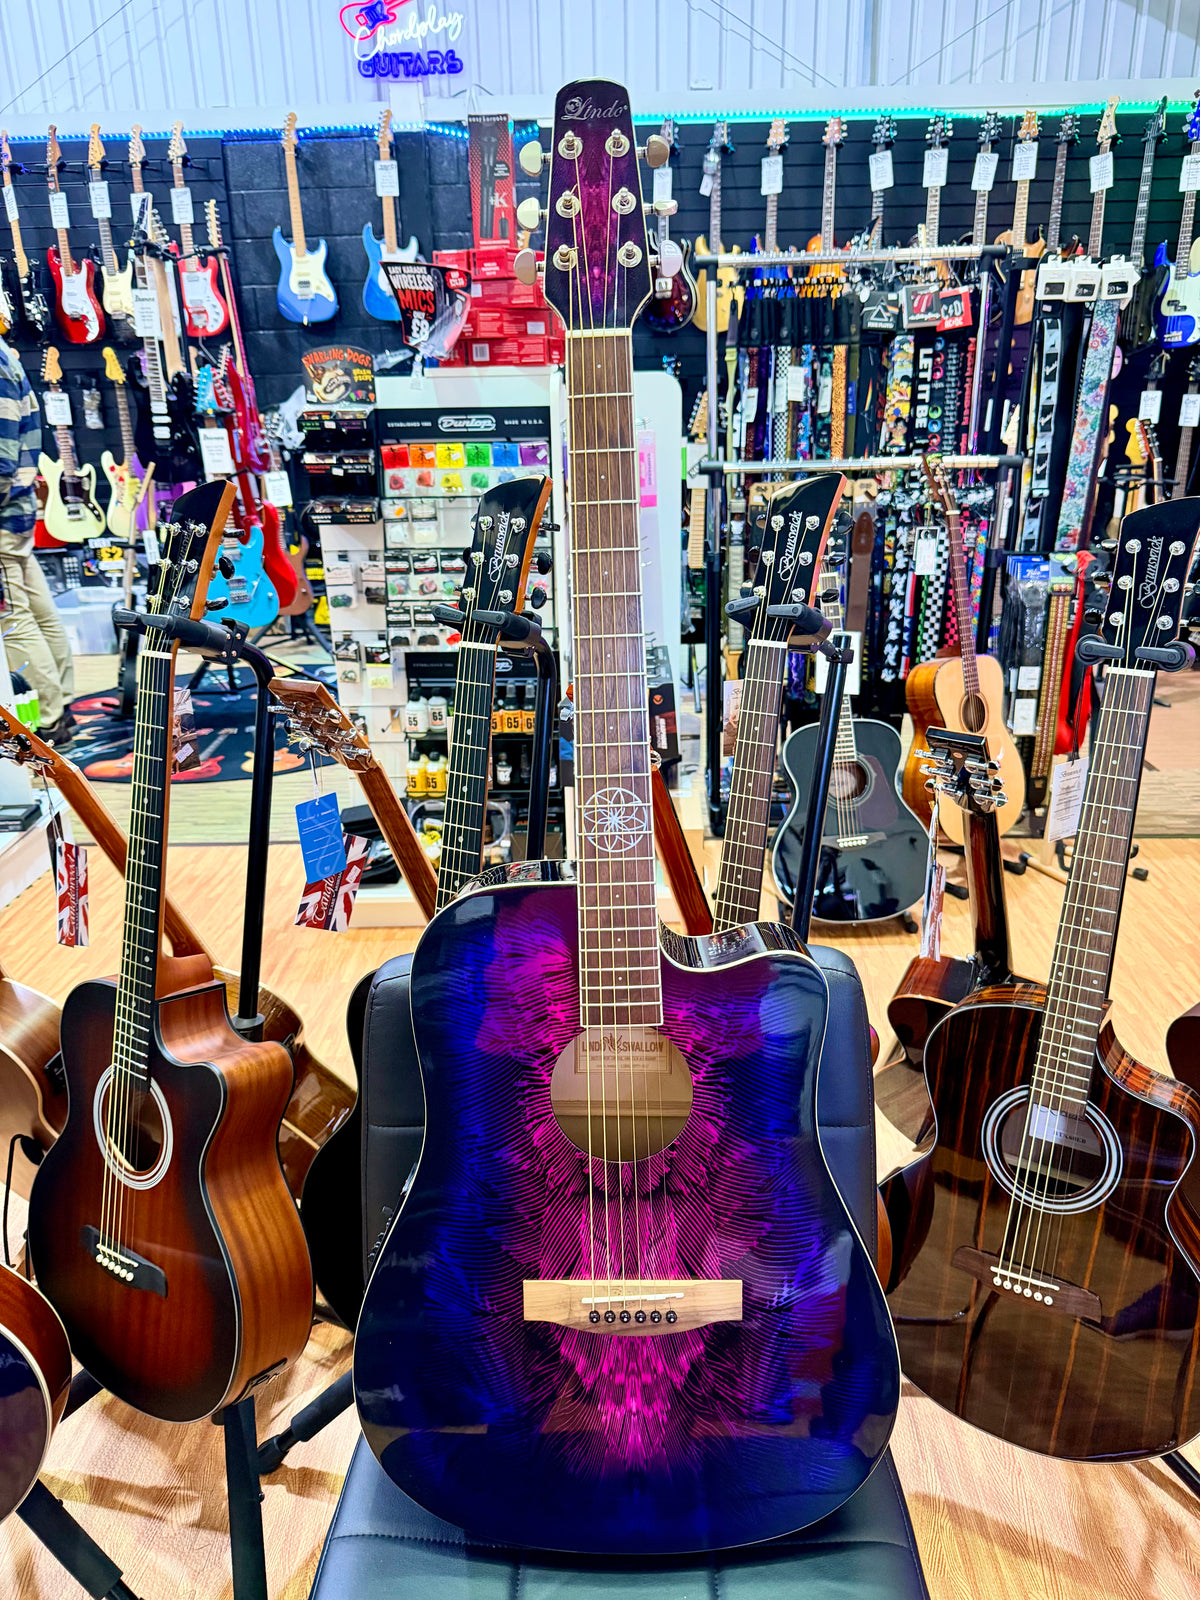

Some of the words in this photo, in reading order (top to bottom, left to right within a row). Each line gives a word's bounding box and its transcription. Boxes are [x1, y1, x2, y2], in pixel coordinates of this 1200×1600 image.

[354, 5, 463, 61] Chordplay
[358, 49, 463, 78] GUITARS
[561, 96, 624, 121] Lindo
[389, 274, 434, 291] WIRELESS
[397, 289, 435, 313] MICS
[302, 348, 345, 368] SNARLING
[346, 348, 371, 367] DOGS
[918, 347, 934, 382] LET
[917, 383, 931, 403] IT
[442, 418, 493, 429] Dunlop
[915, 404, 929, 429] BE
[488, 511, 511, 582] Brunswick
[777, 510, 803, 581] Brunswick
[1137, 535, 1165, 608] Brunswick
[408, 716, 418, 727] 65
[432, 711, 443, 721] 65
[506, 717, 519, 729] 65
[426, 777, 437, 789] 65
[312, 874, 336, 924] Tangle
[582, 1040, 606, 1052] LNDO
[622, 1041, 664, 1052] SWALLOW
